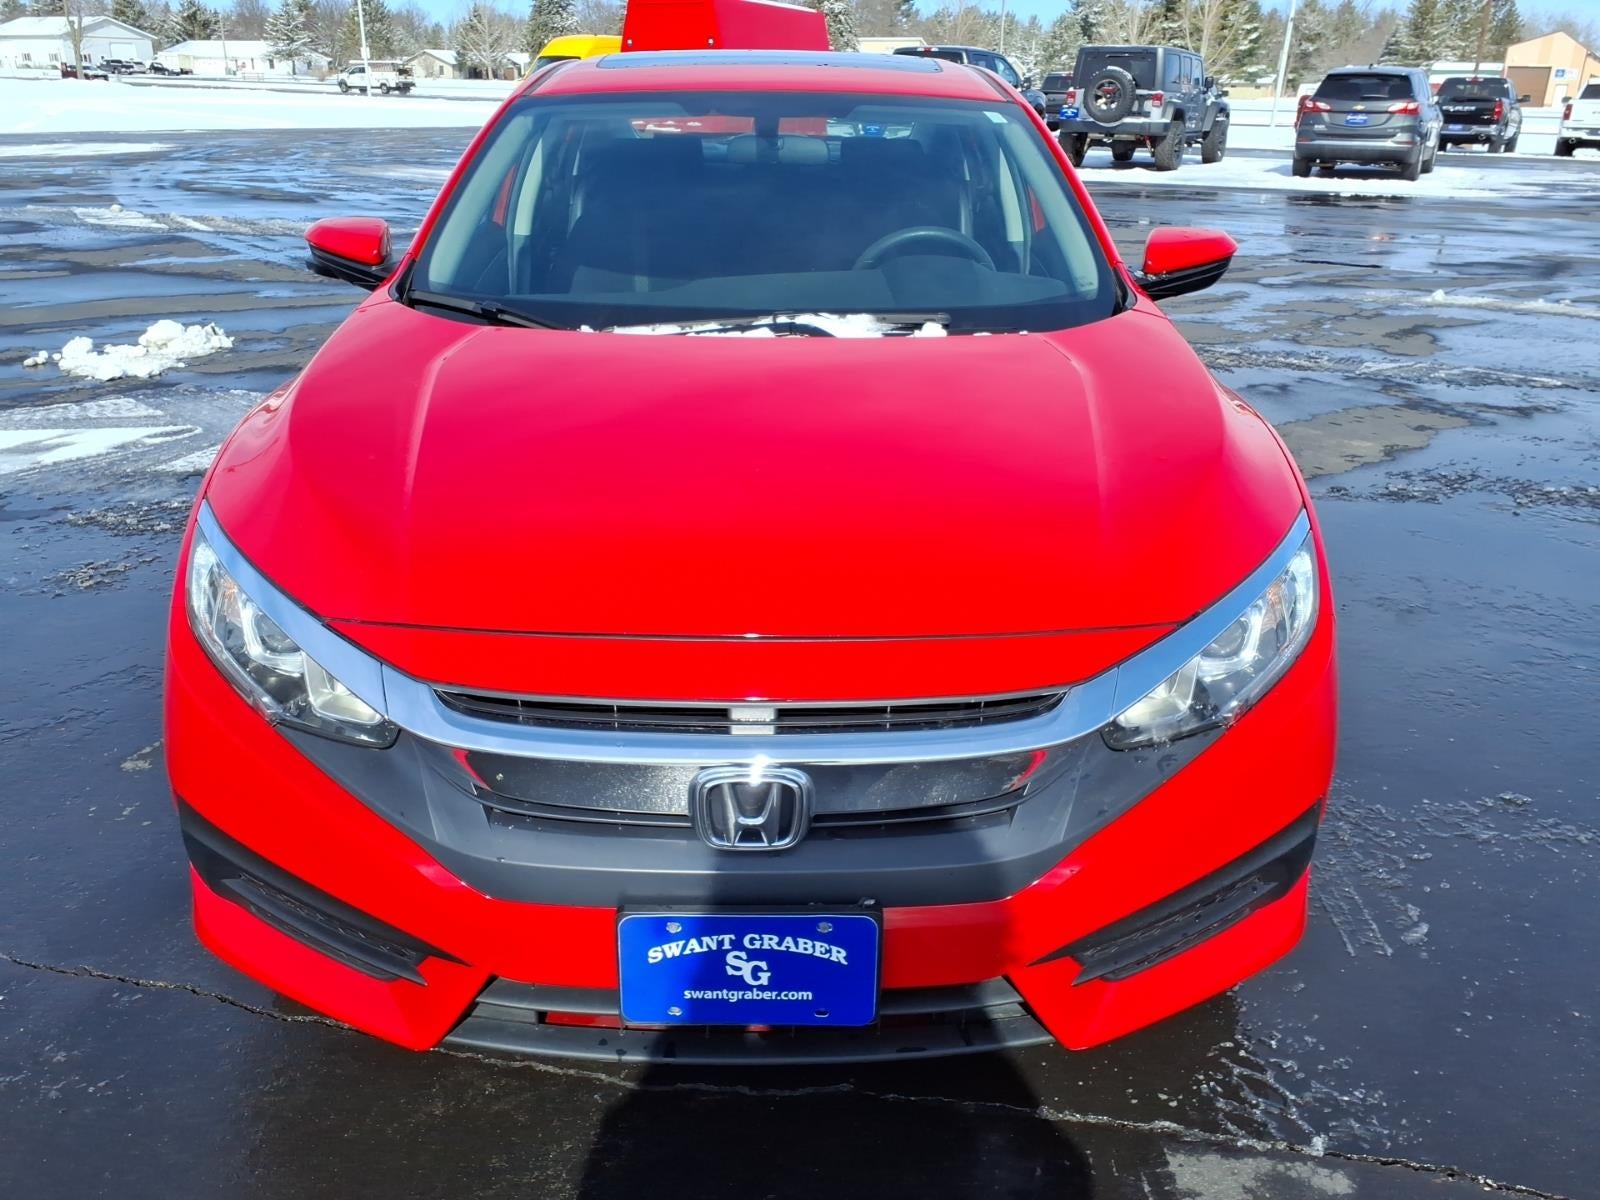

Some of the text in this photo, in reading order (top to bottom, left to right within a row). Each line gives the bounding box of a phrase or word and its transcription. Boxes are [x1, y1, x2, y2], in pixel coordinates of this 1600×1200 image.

[647, 934, 848, 965] SWANT GRABER
[725, 951, 771, 986] SG
[683, 988, 813, 1003] swantgraber.com
